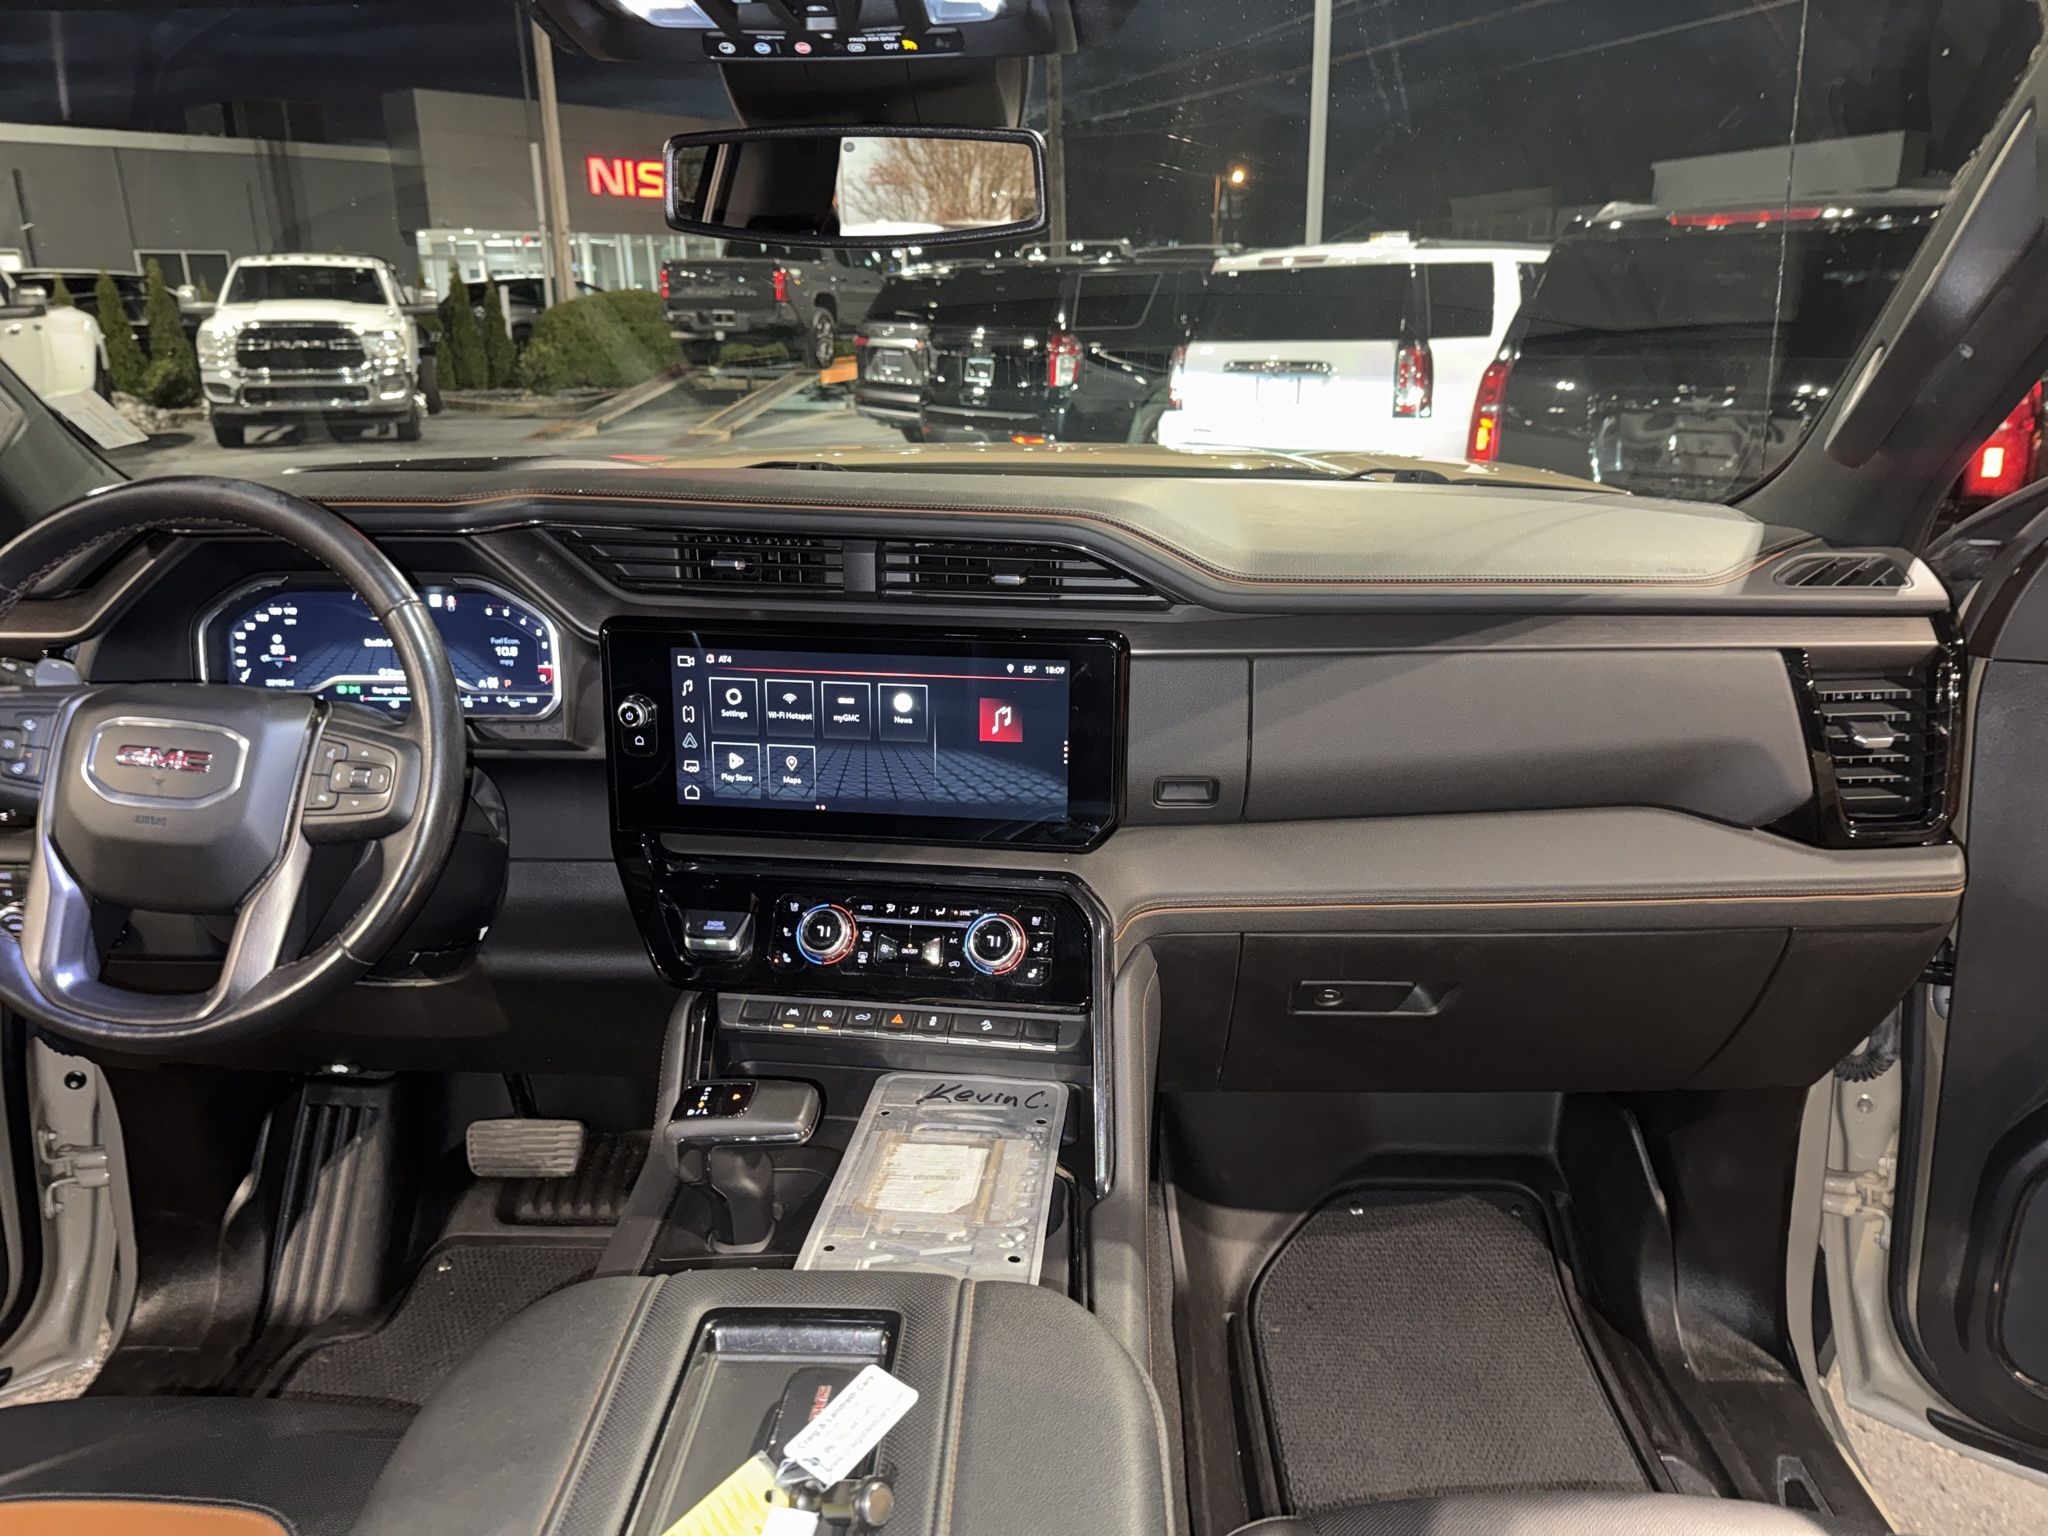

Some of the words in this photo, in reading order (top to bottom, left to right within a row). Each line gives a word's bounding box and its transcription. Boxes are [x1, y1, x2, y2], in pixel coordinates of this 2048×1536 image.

[718, 655, 732, 663] AT4
[1045, 666, 1065, 674] 18:09
[721, 709, 748, 720] Settings
[768, 711, 786, 719] Wi-Fi
[786, 711, 813, 721] Hotspot
[833, 714, 860, 723] myGMC
[894, 716, 913, 724] News
[721, 772, 735, 782] Play
[736, 773, 753, 782] Store
[783, 775, 802, 785] Maps
[817, 925, 831, 937] 71
[986, 935, 1001, 947] 71
[916, 1083, 1018, 1107] Kevin
